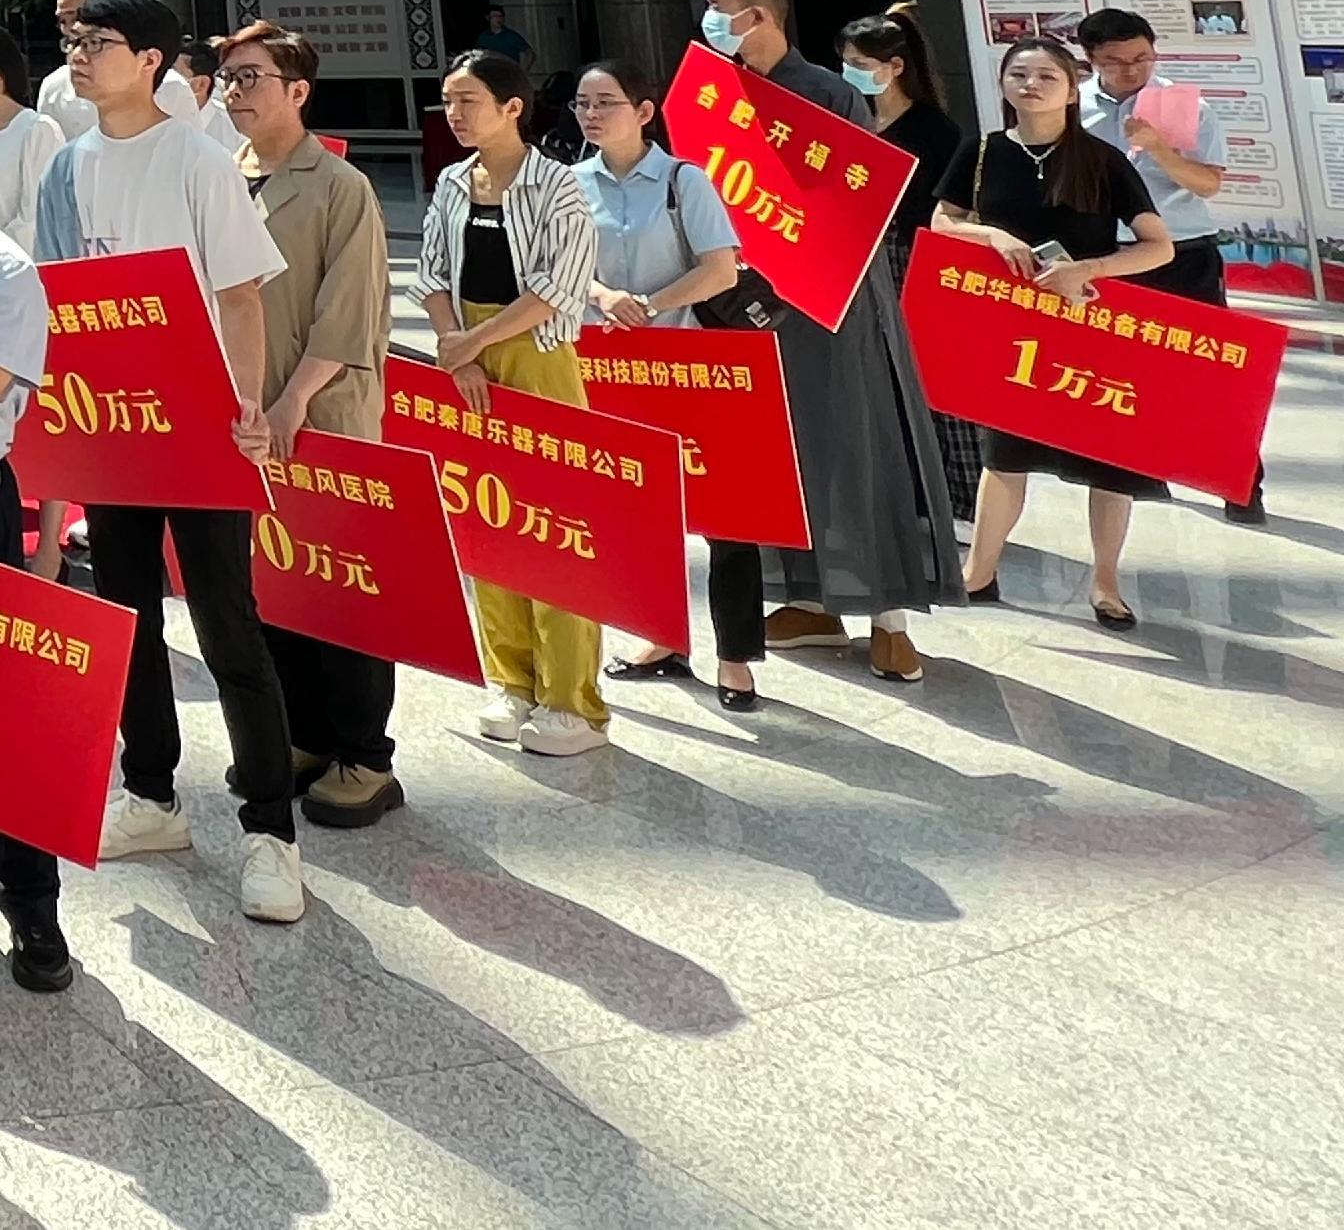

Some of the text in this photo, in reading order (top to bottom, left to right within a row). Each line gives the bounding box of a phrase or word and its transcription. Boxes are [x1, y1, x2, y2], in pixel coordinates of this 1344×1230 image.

[697, 83, 870, 191] 合肥开福寺
[703, 146, 805, 244] 10万元
[939, 266, 1248, 369] 合肥华峰暖通设备有限公司
[37, 372, 173, 436] 50万元
[1004, 338, 1139, 417] 1万元
[251, 514, 380, 595] 0万元
[440, 460, 596, 559] 50万元
